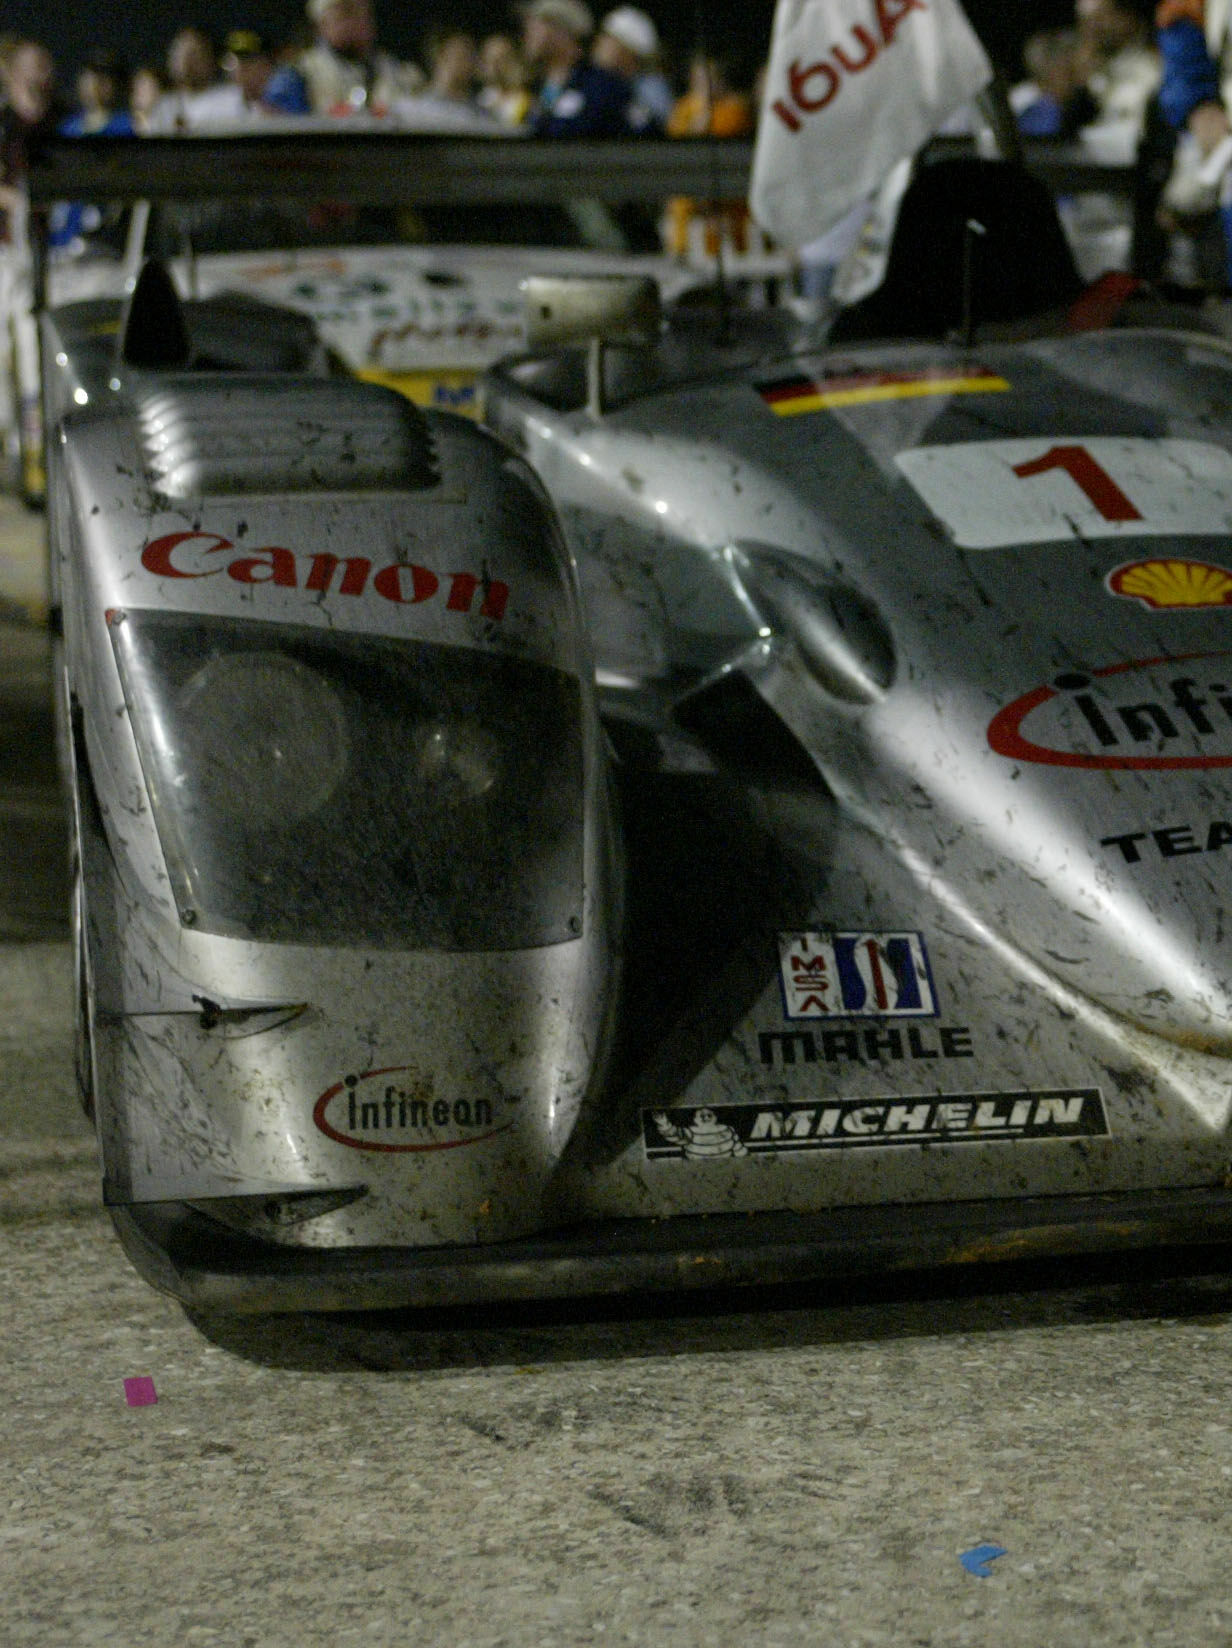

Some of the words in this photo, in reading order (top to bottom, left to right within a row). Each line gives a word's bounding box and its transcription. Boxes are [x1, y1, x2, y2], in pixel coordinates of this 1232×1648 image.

[1012, 446, 1144, 521] 1
[141, 531, 509, 621] Canon
[791, 935, 829, 1012] IMSA
[758, 1027, 975, 1064] MAHLE
[750, 1096, 1086, 1139] MICHELIN
